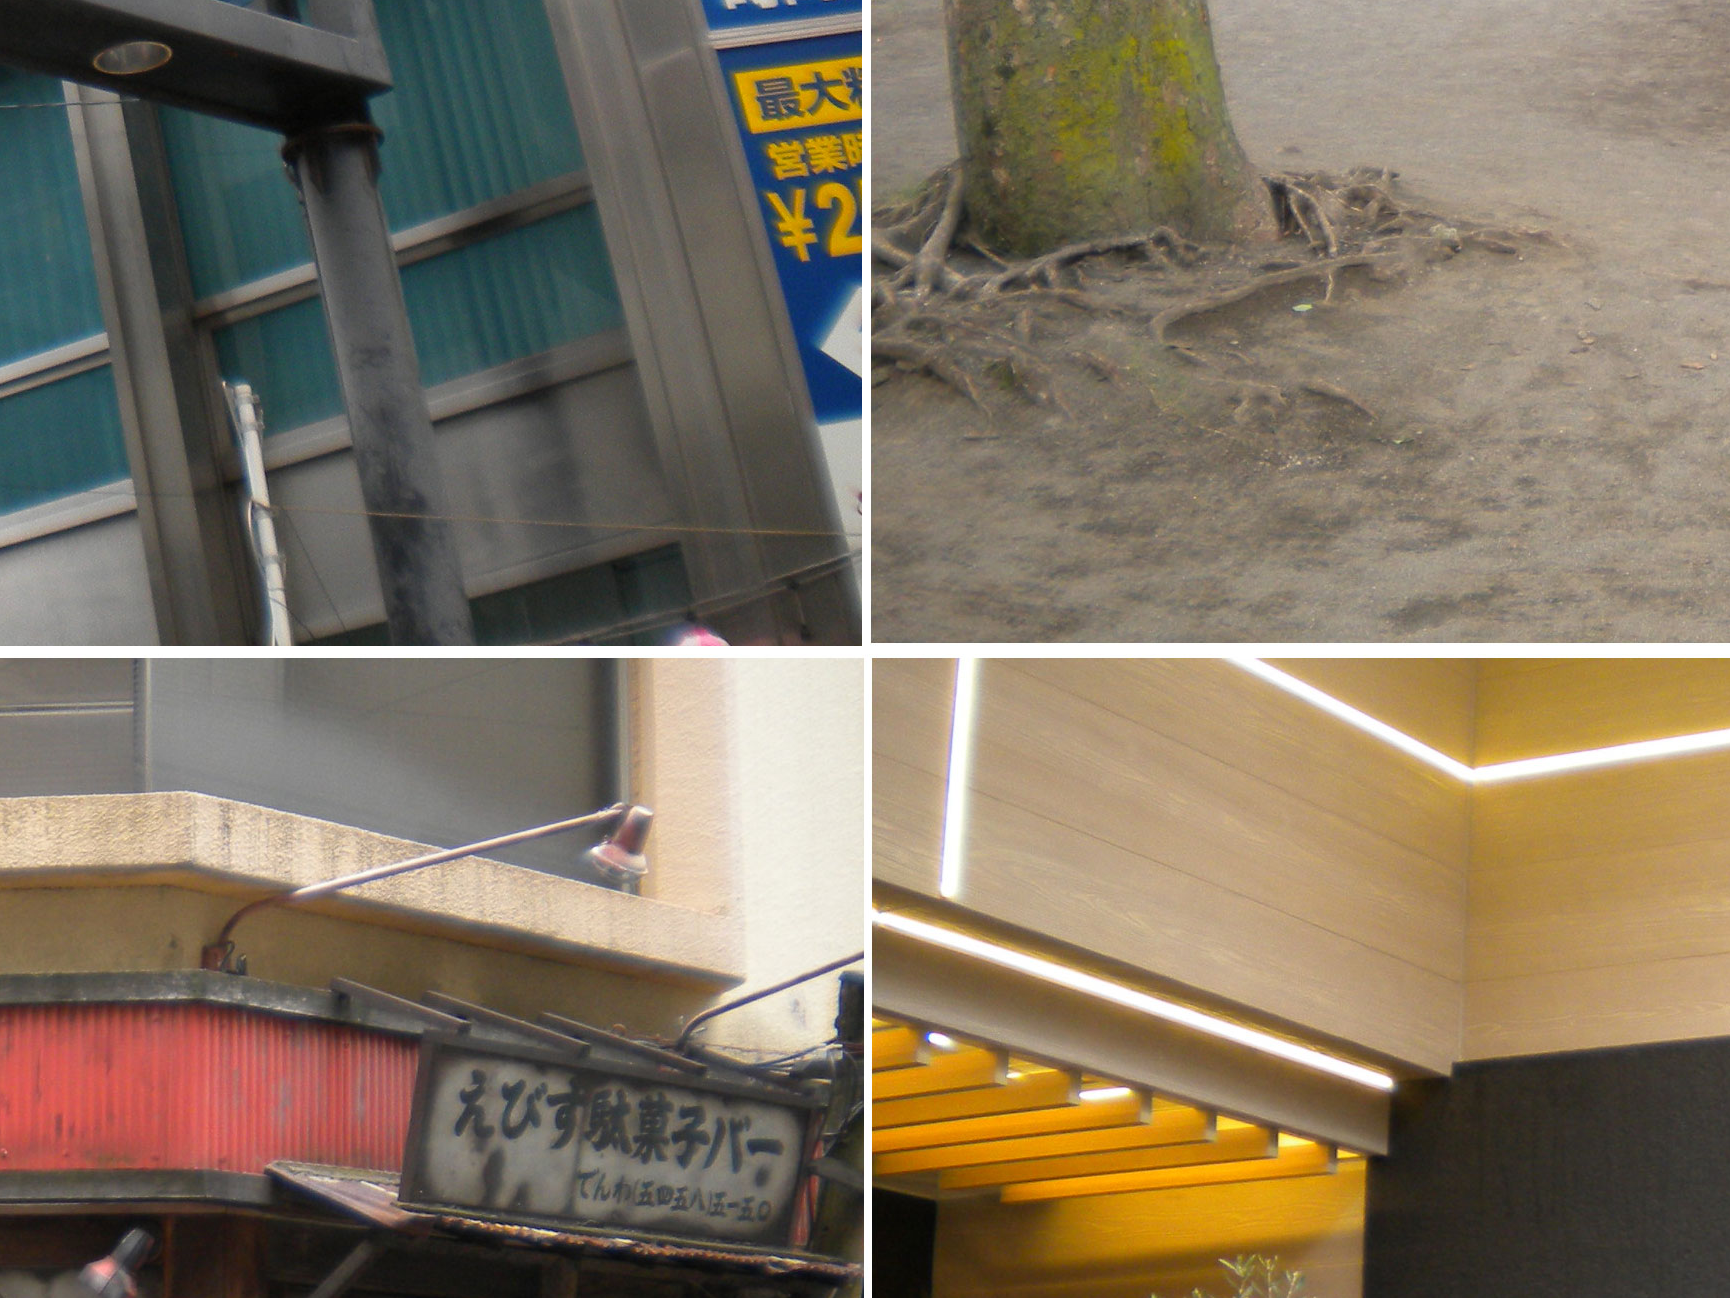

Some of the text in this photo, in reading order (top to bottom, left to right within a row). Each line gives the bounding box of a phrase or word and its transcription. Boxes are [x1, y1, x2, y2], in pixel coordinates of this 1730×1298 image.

[455, 1069, 783, 1174] えびす駄菓子バー
